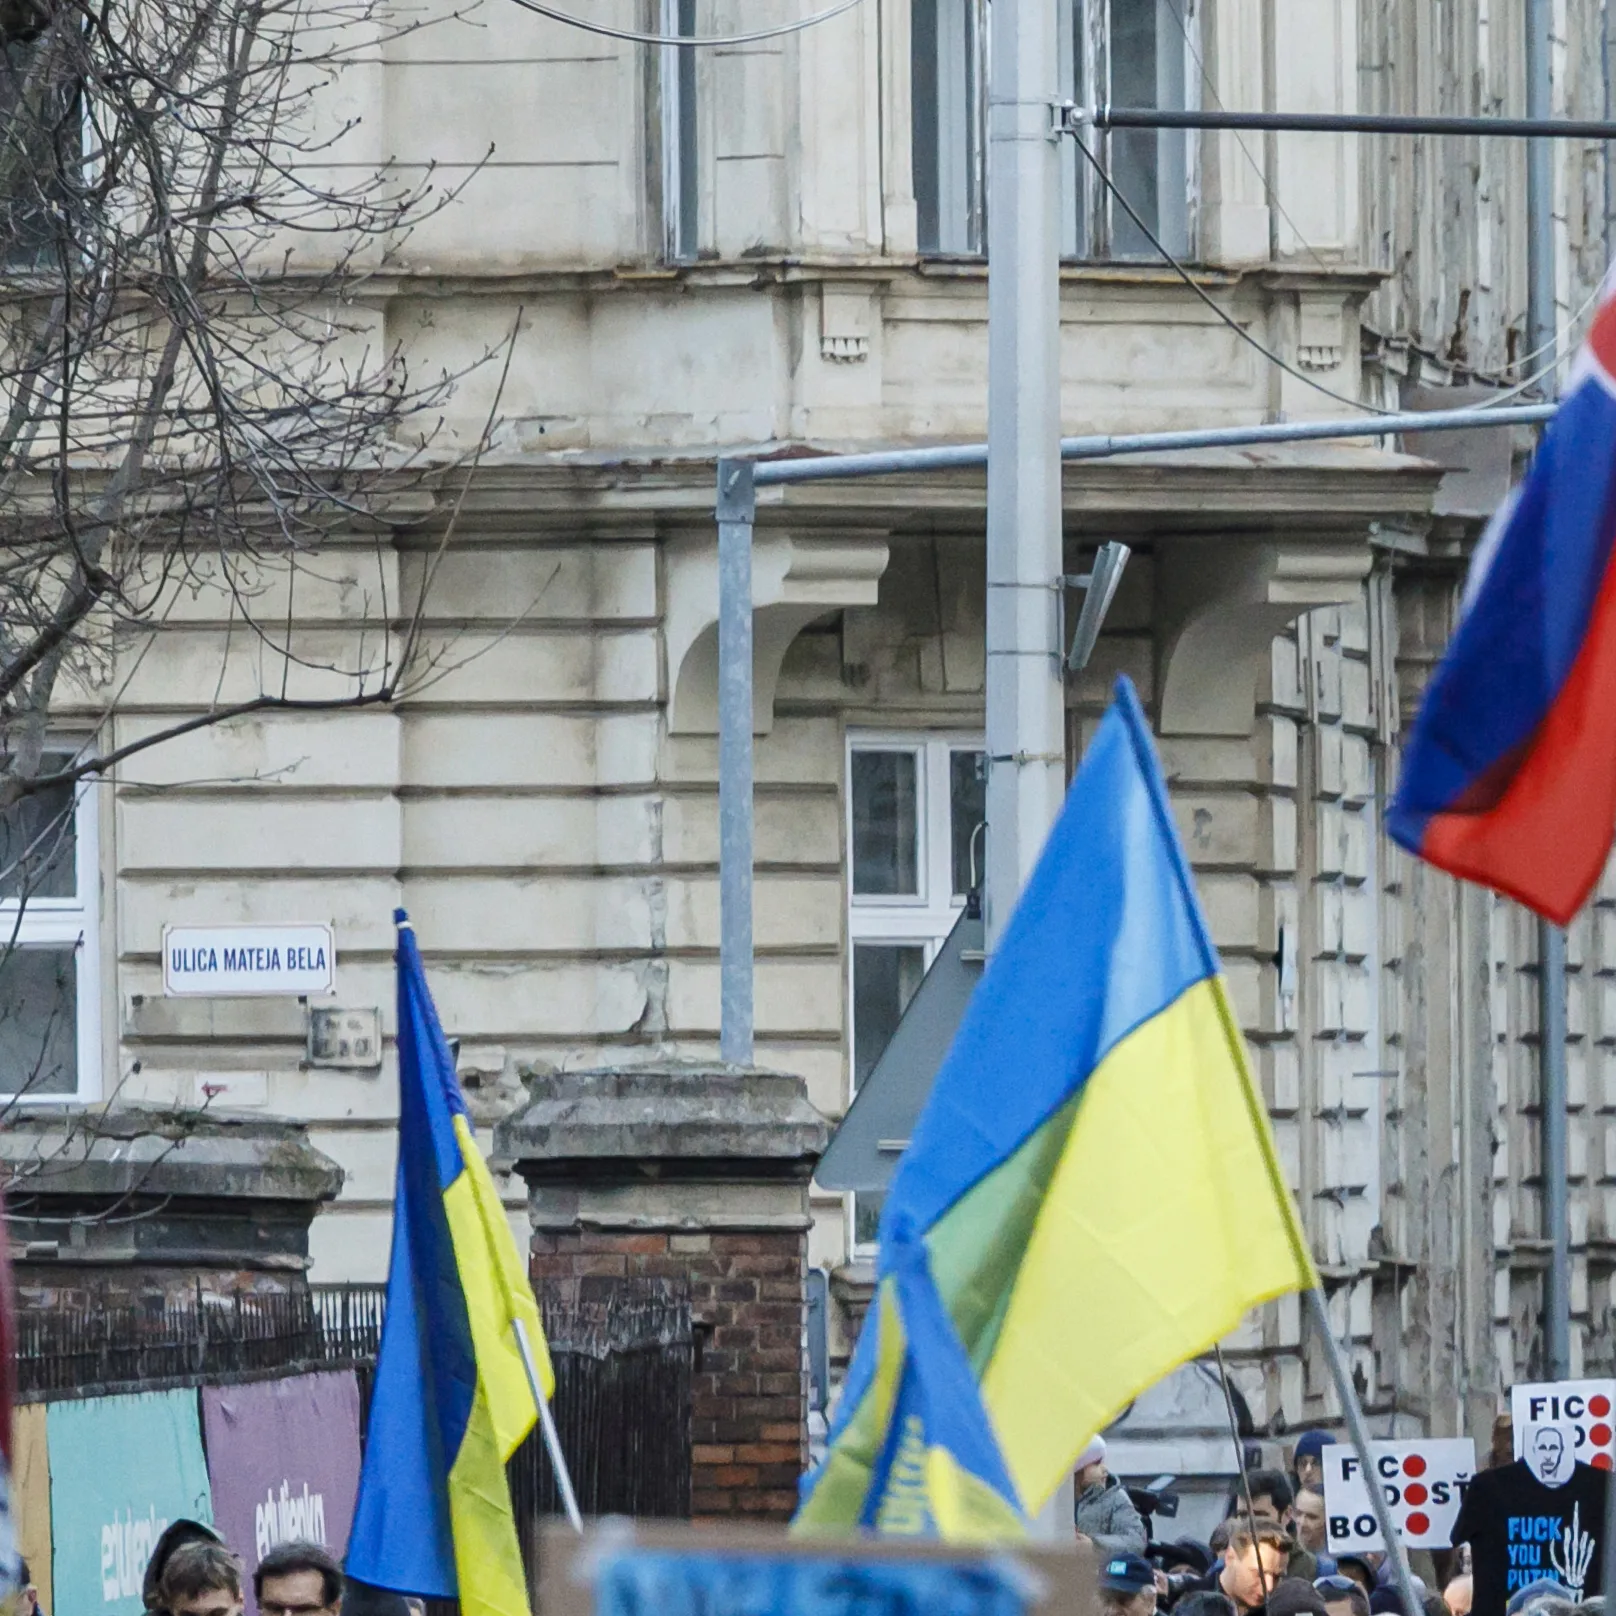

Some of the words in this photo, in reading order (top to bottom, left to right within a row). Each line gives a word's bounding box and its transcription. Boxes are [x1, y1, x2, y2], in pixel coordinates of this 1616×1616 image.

[172, 948, 218, 972] ULICA
[224, 947, 281, 972] MATEJA
[287, 947, 326, 971] BELA
[1508, 1516, 1562, 1541] FUCK
[1507, 1544, 1541, 1566] YOU
